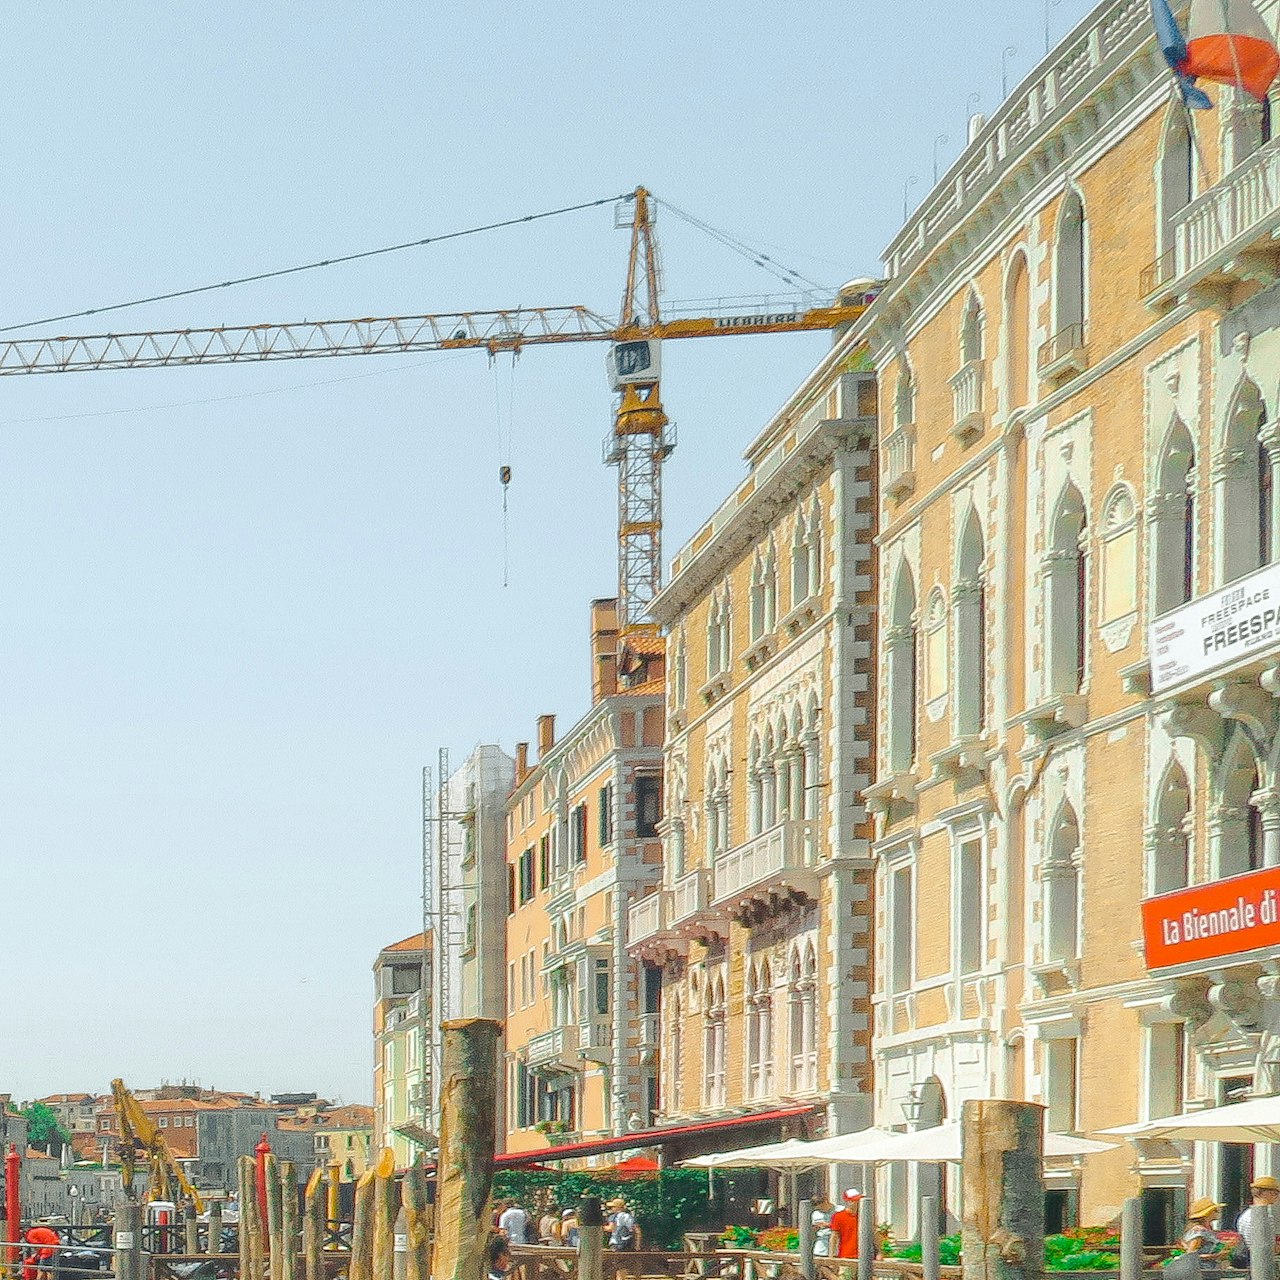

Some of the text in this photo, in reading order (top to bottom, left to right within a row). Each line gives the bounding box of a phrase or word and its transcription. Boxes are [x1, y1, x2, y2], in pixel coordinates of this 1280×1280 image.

[719, 313, 797, 327] LIEBHERR
[1201, 588, 1270, 628] FREESPACE
[1162, 889, 1277, 946] la Biennale di
